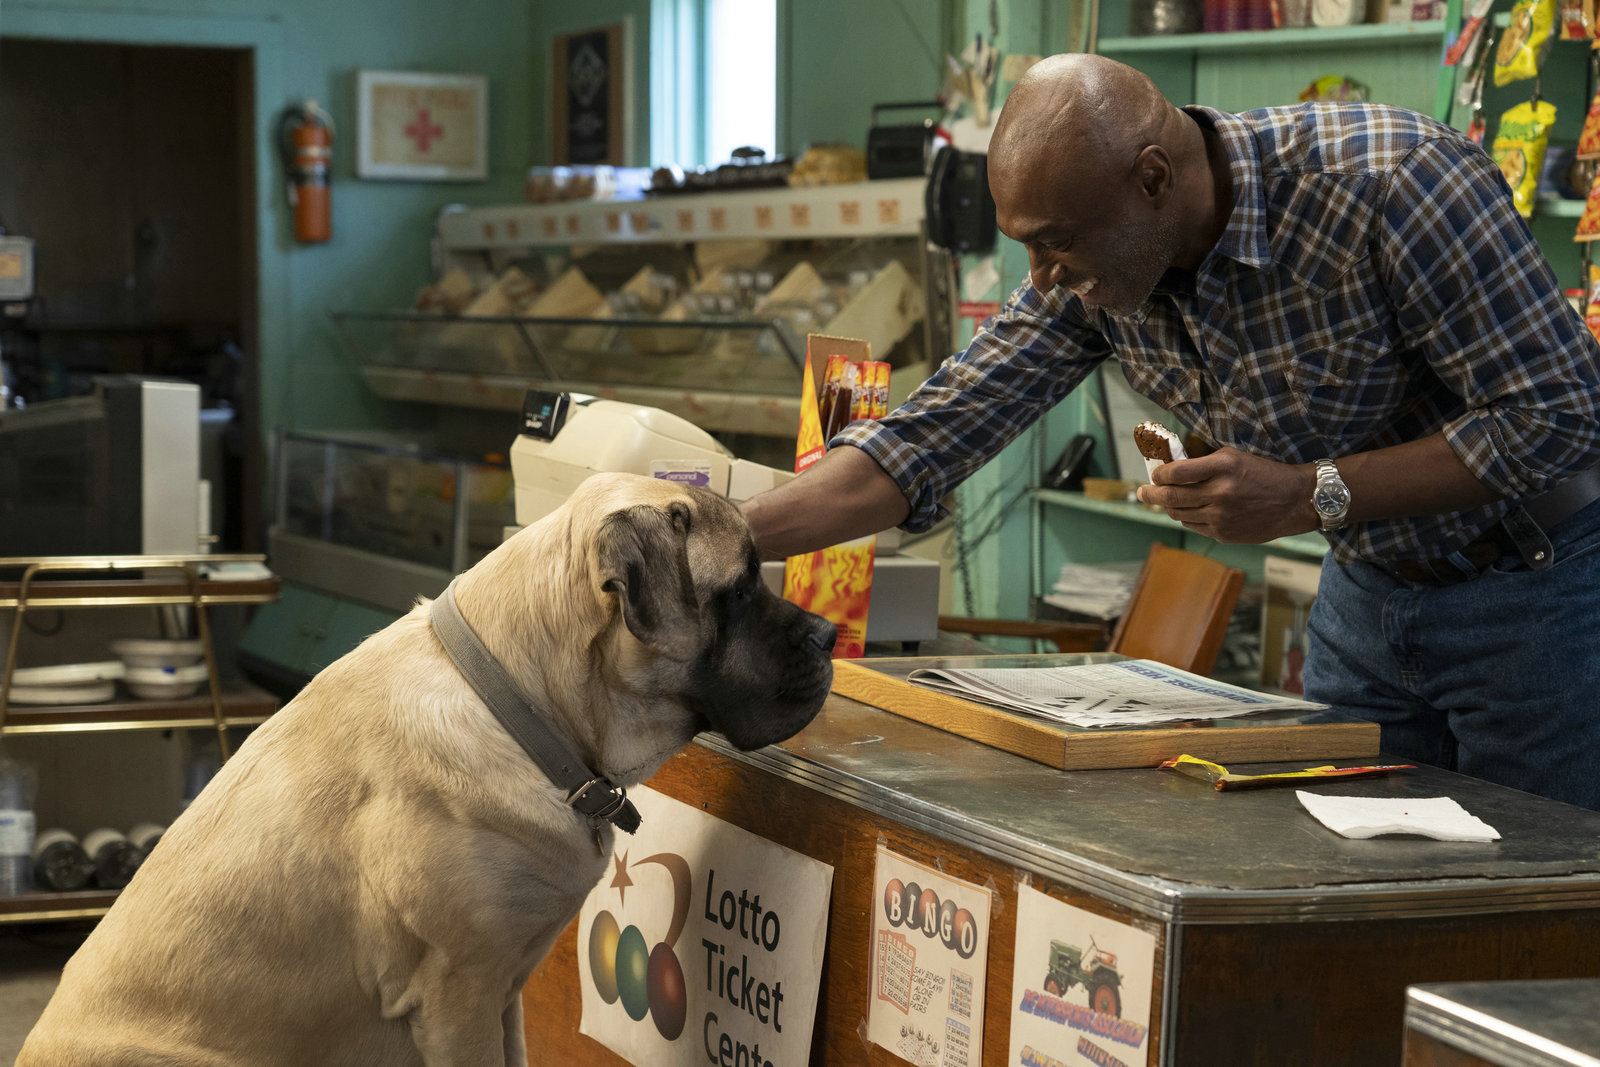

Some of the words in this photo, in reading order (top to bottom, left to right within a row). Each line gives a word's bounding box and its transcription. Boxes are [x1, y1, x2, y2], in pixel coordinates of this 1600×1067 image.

[799, 450, 823, 468] ORIGINAL
[666, 472, 697, 481] personal
[1163, 678, 1264, 704] ADVERTISE
[705, 869, 780, 952] Lotto
[889, 890, 974, 954] BINGO
[914, 966, 926, 976] SAY
[702, 938, 784, 1034] Ticket
[911, 974, 926, 987] COME
[912, 993, 921, 1003] OR
[921, 997, 930, 1006] IN
[914, 985, 934, 999] ALONE
[909, 1001, 928, 1014] PAIRS
[1088, 1010, 1148, 1048] ASSOCIATION
